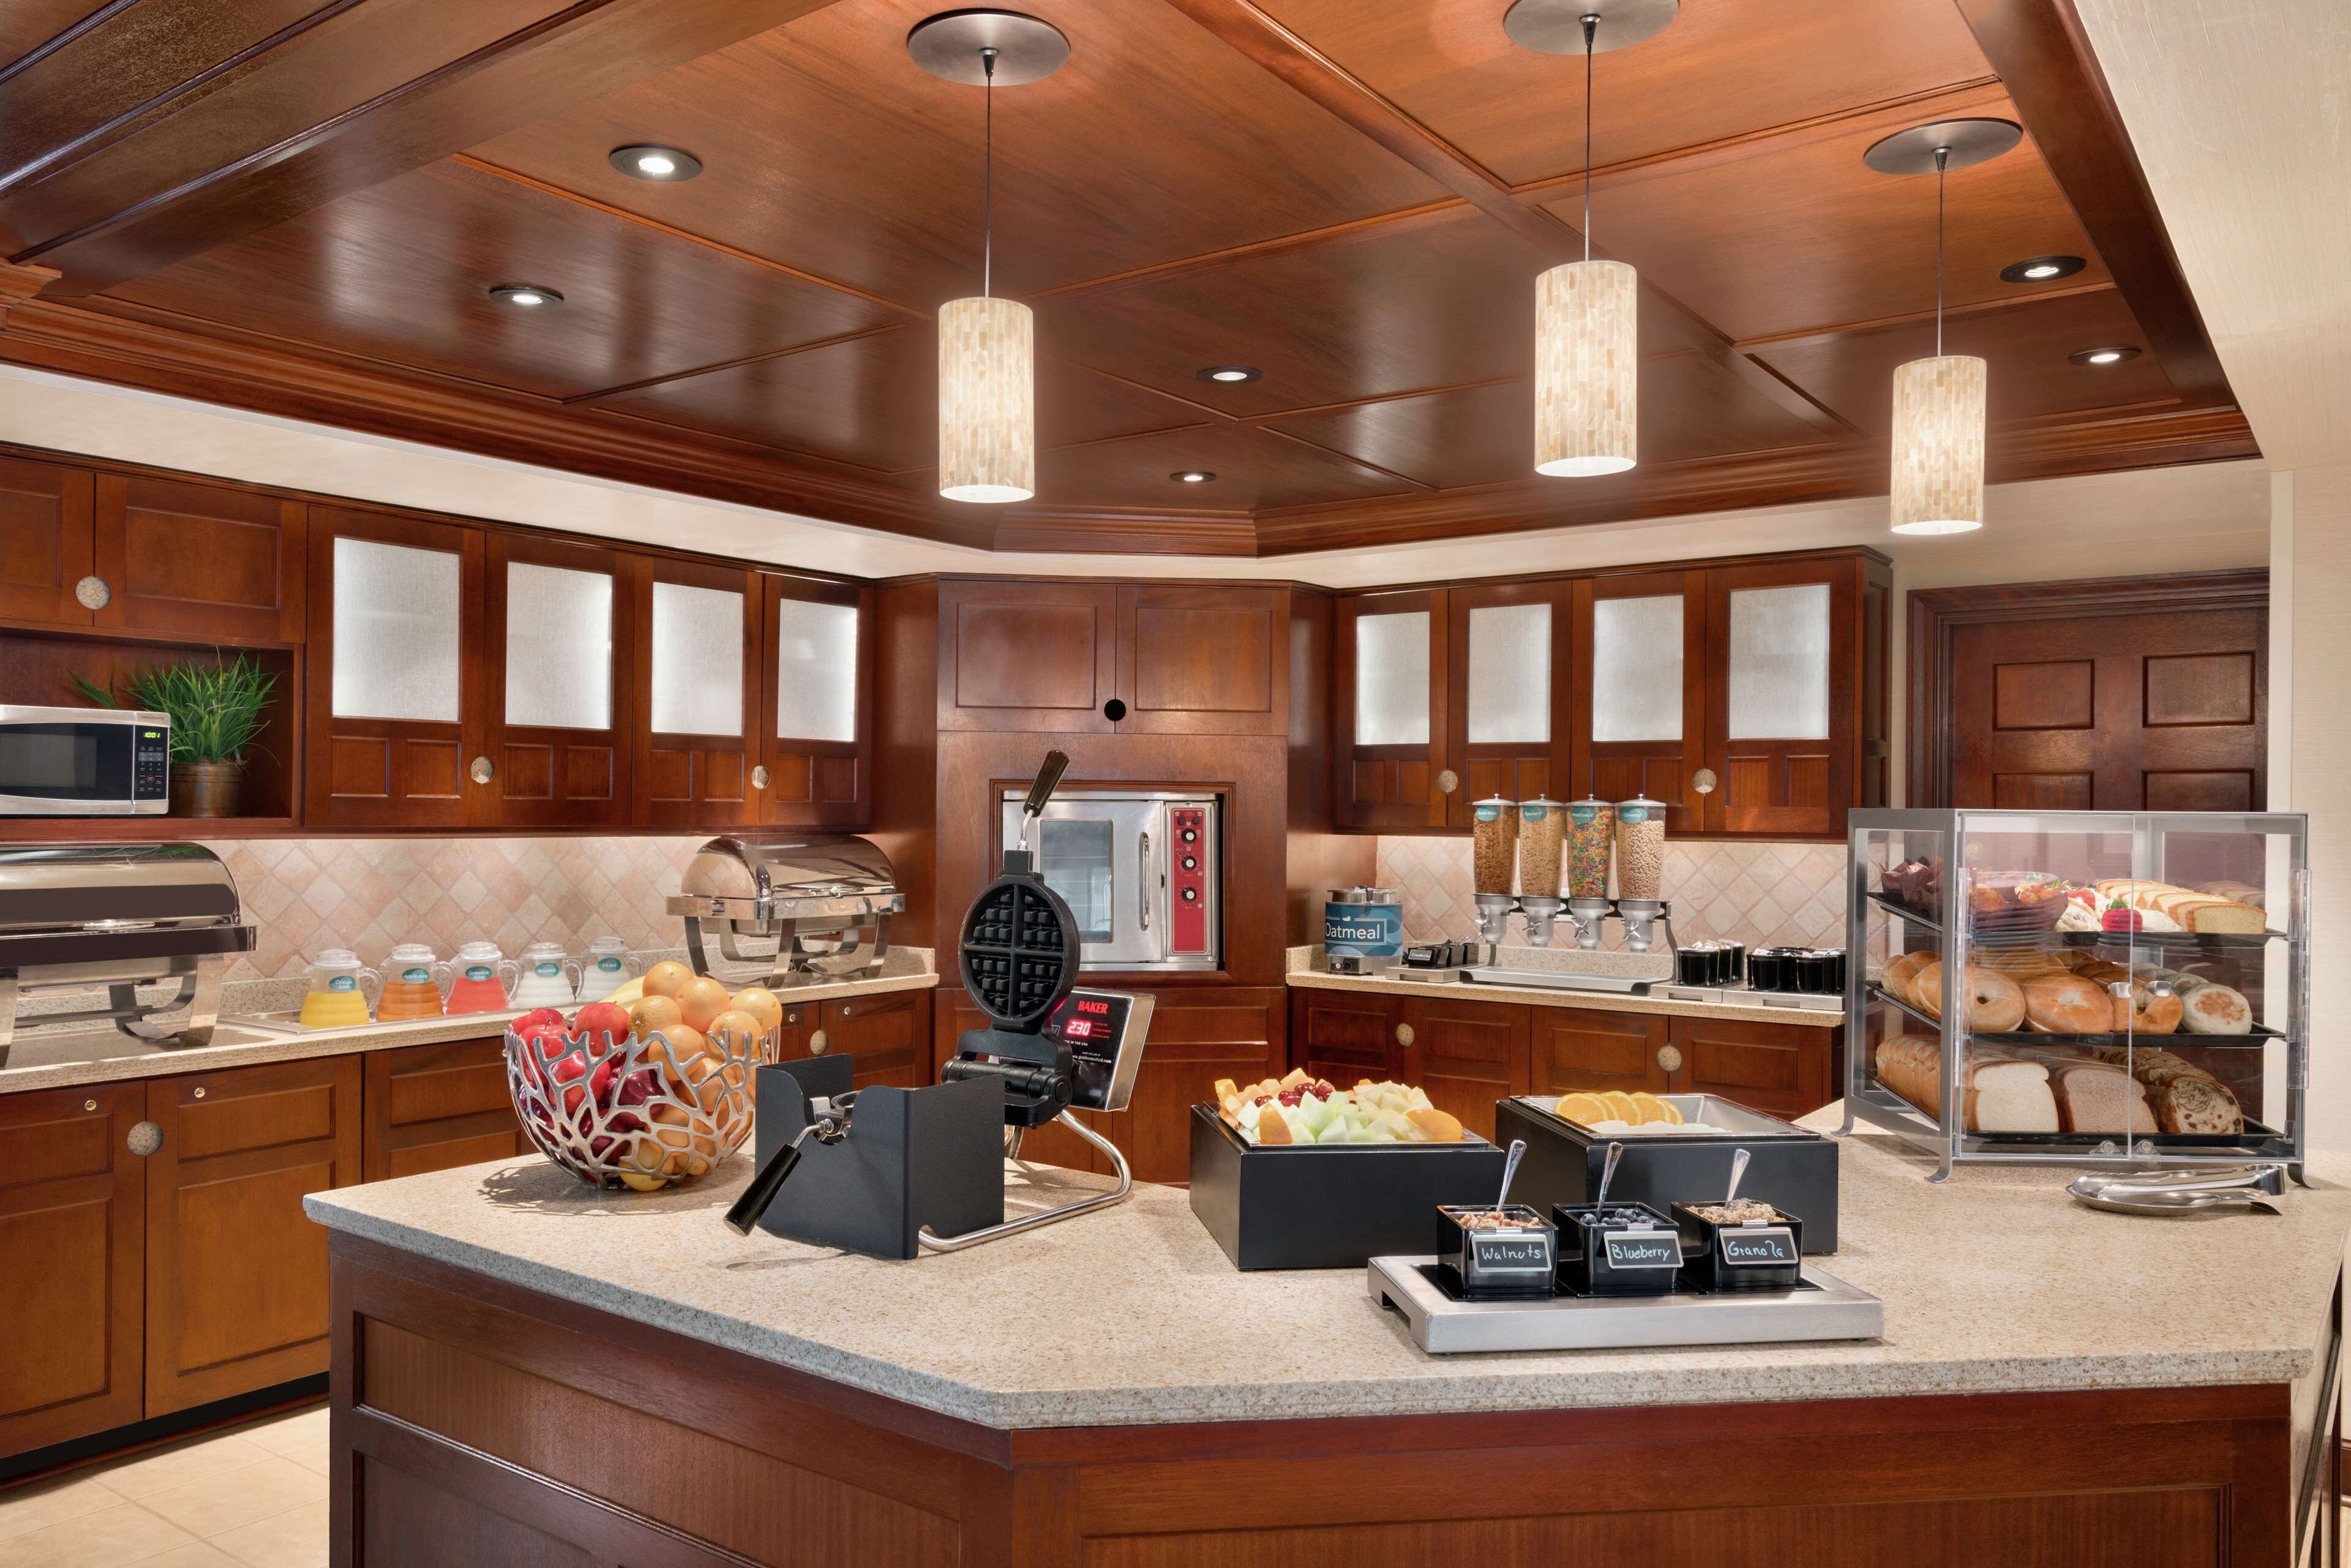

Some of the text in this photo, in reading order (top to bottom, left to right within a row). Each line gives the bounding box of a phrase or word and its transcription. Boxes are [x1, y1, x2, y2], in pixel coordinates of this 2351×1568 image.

[1325, 922, 1380, 939] Oatmeal
[1078, 1000, 1108, 1015] BAKER
[1482, 1244, 1541, 1260] Walnuts
[1611, 1244, 1670, 1262] Blueberry
[1728, 1240, 1784, 1258] Granola
